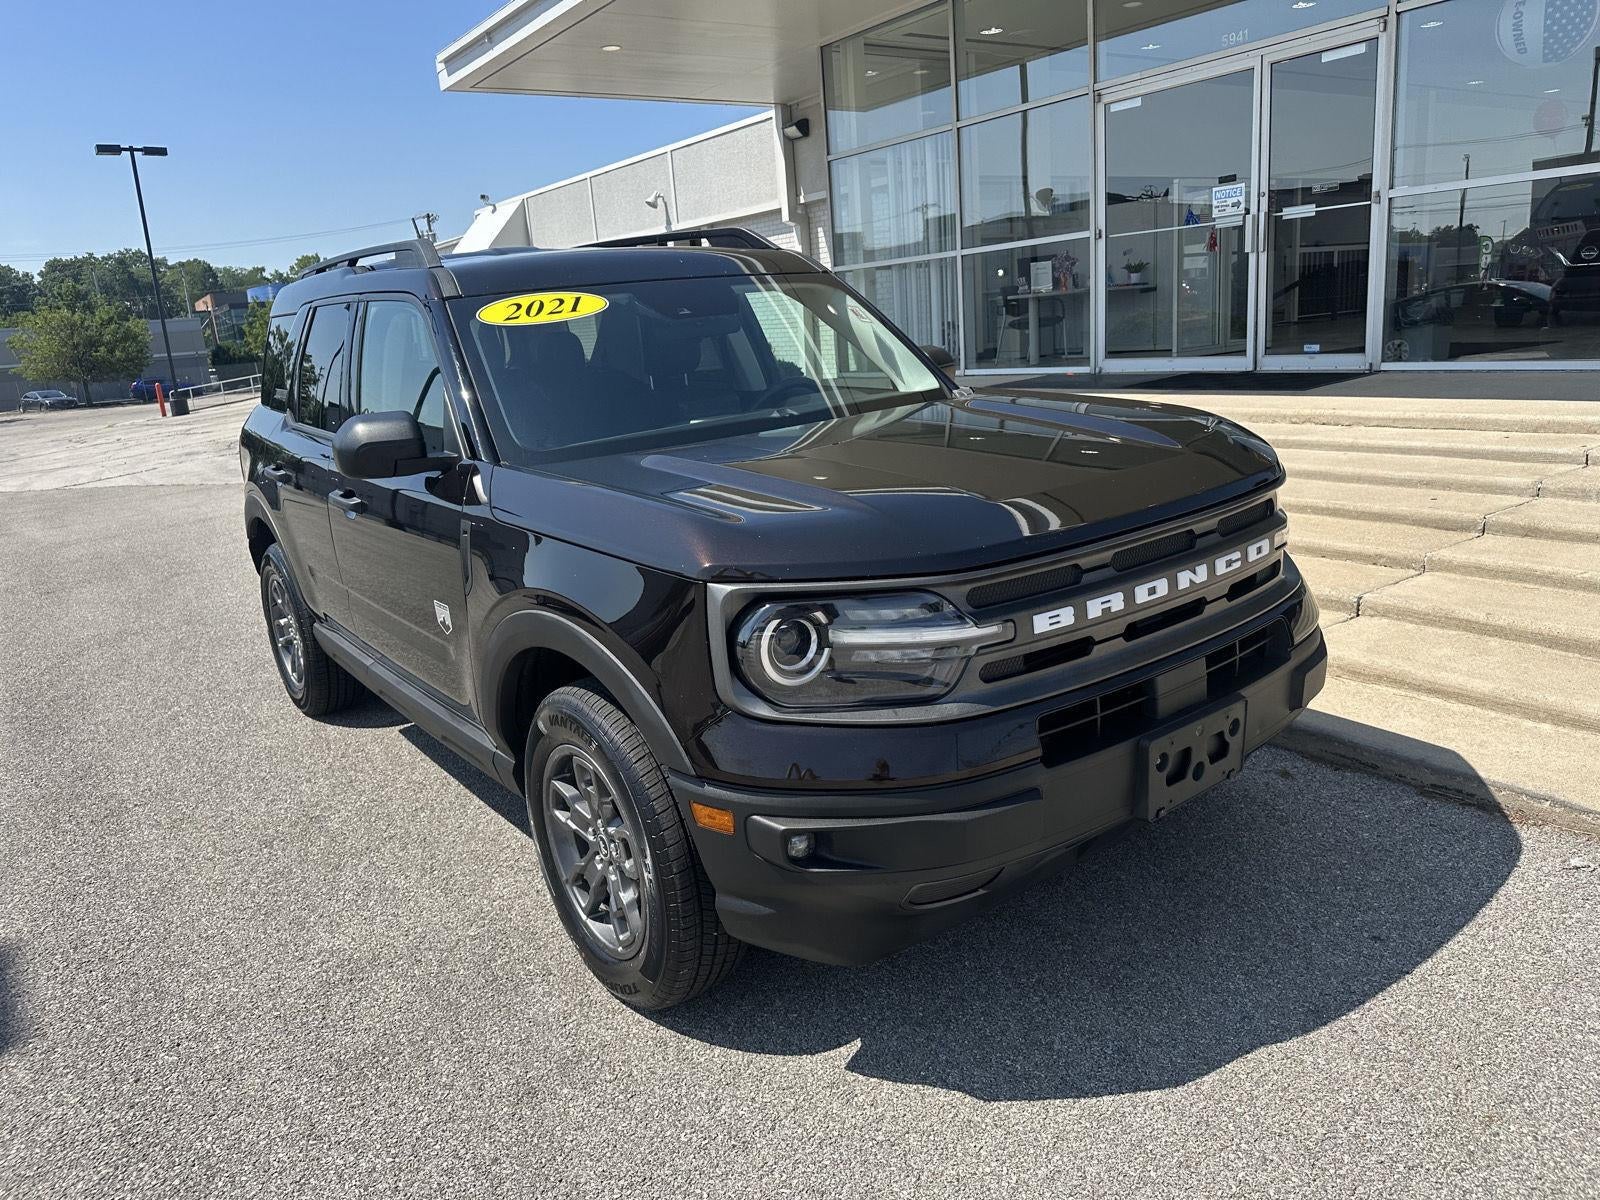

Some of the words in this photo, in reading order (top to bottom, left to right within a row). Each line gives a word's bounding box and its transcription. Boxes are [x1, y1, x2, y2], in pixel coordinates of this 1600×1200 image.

[1222, 29, 1249, 47] 5941
[1215, 187, 1242, 199] NOTICE
[503, 296, 581, 321] 2021
[1032, 538, 1270, 635] BRONCO
